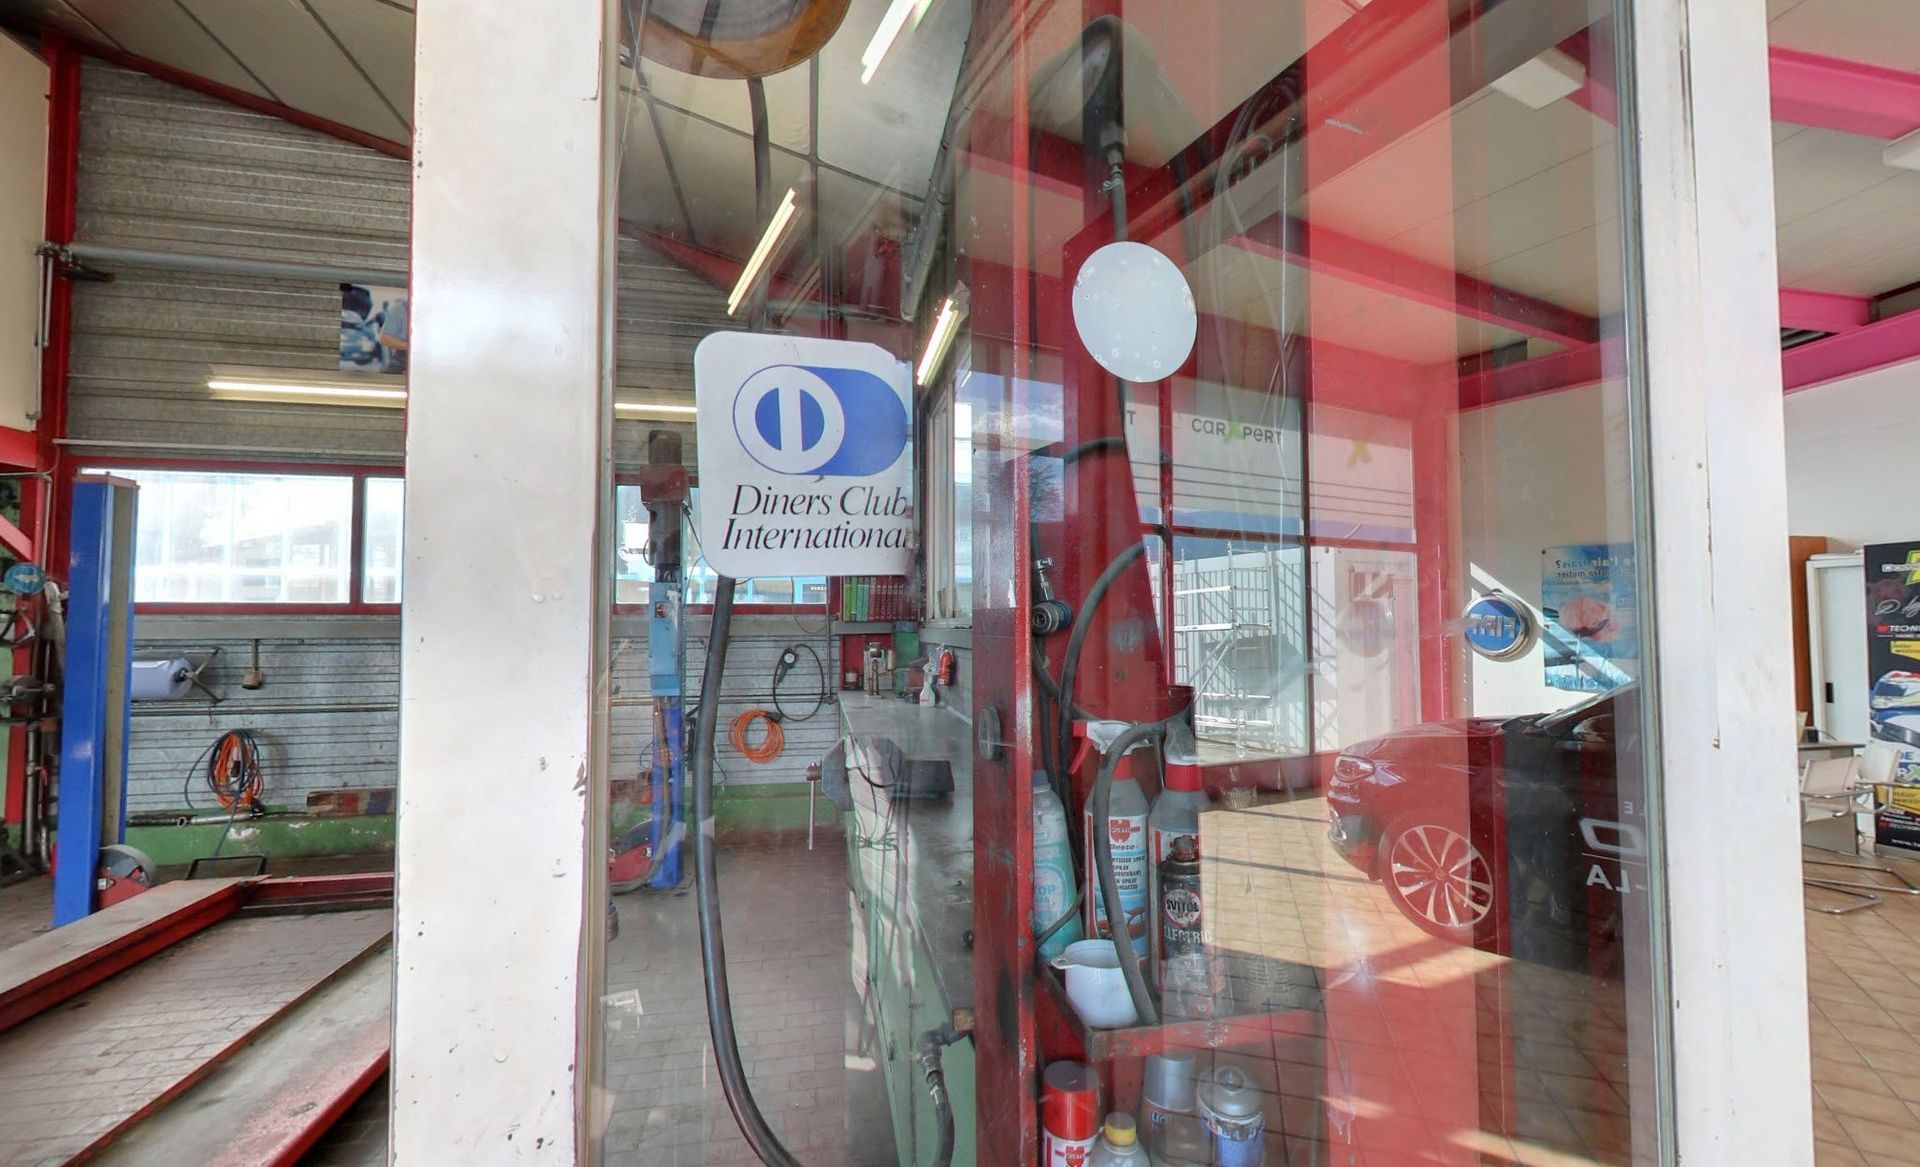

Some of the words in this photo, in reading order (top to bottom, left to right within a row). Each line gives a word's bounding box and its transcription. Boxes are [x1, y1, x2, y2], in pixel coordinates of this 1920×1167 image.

[731, 484, 833, 516] Diners
[839, 485, 907, 516] Club
[721, 518, 907, 550] Internationa
